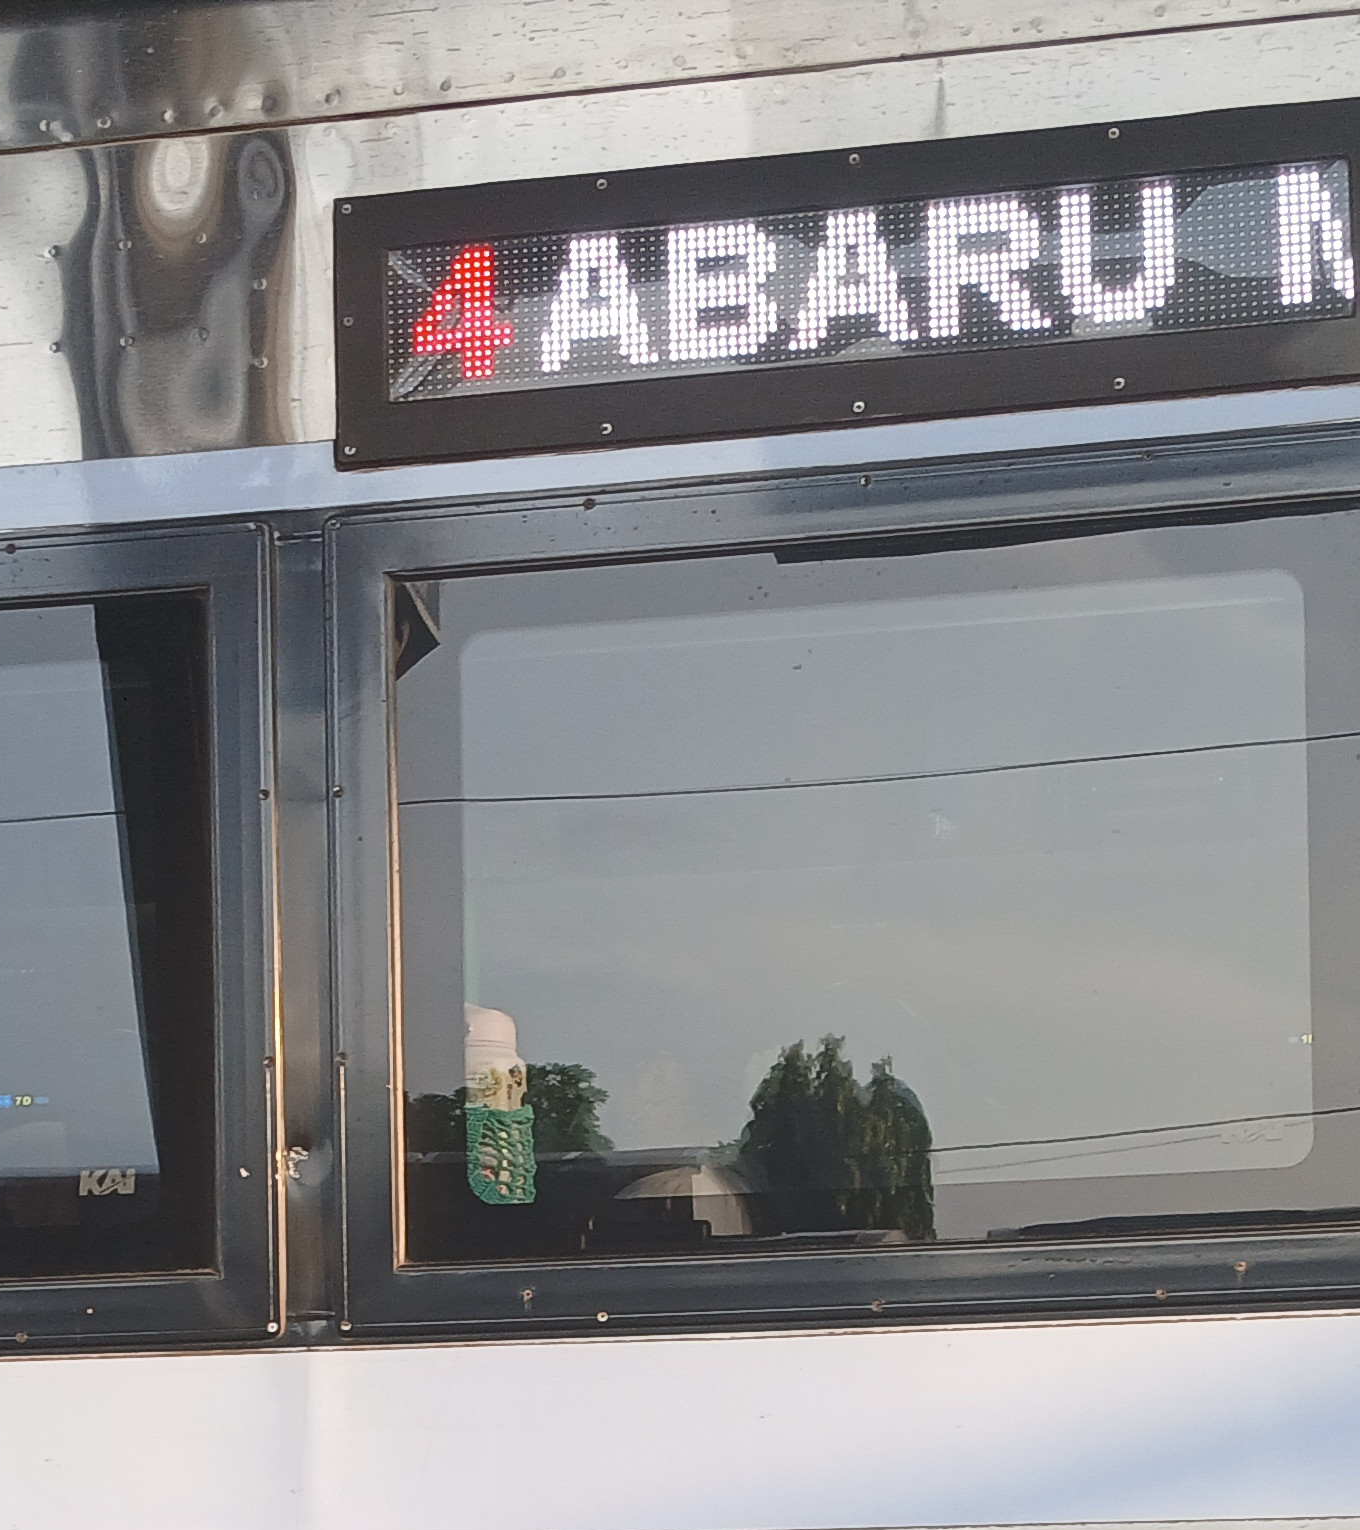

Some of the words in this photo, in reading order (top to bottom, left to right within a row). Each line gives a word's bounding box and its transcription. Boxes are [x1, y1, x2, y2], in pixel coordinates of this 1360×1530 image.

[413, 244, 513, 378] 4
[541, 184, 1174, 372] ABARU
[79, 1168, 135, 1196] KAI
